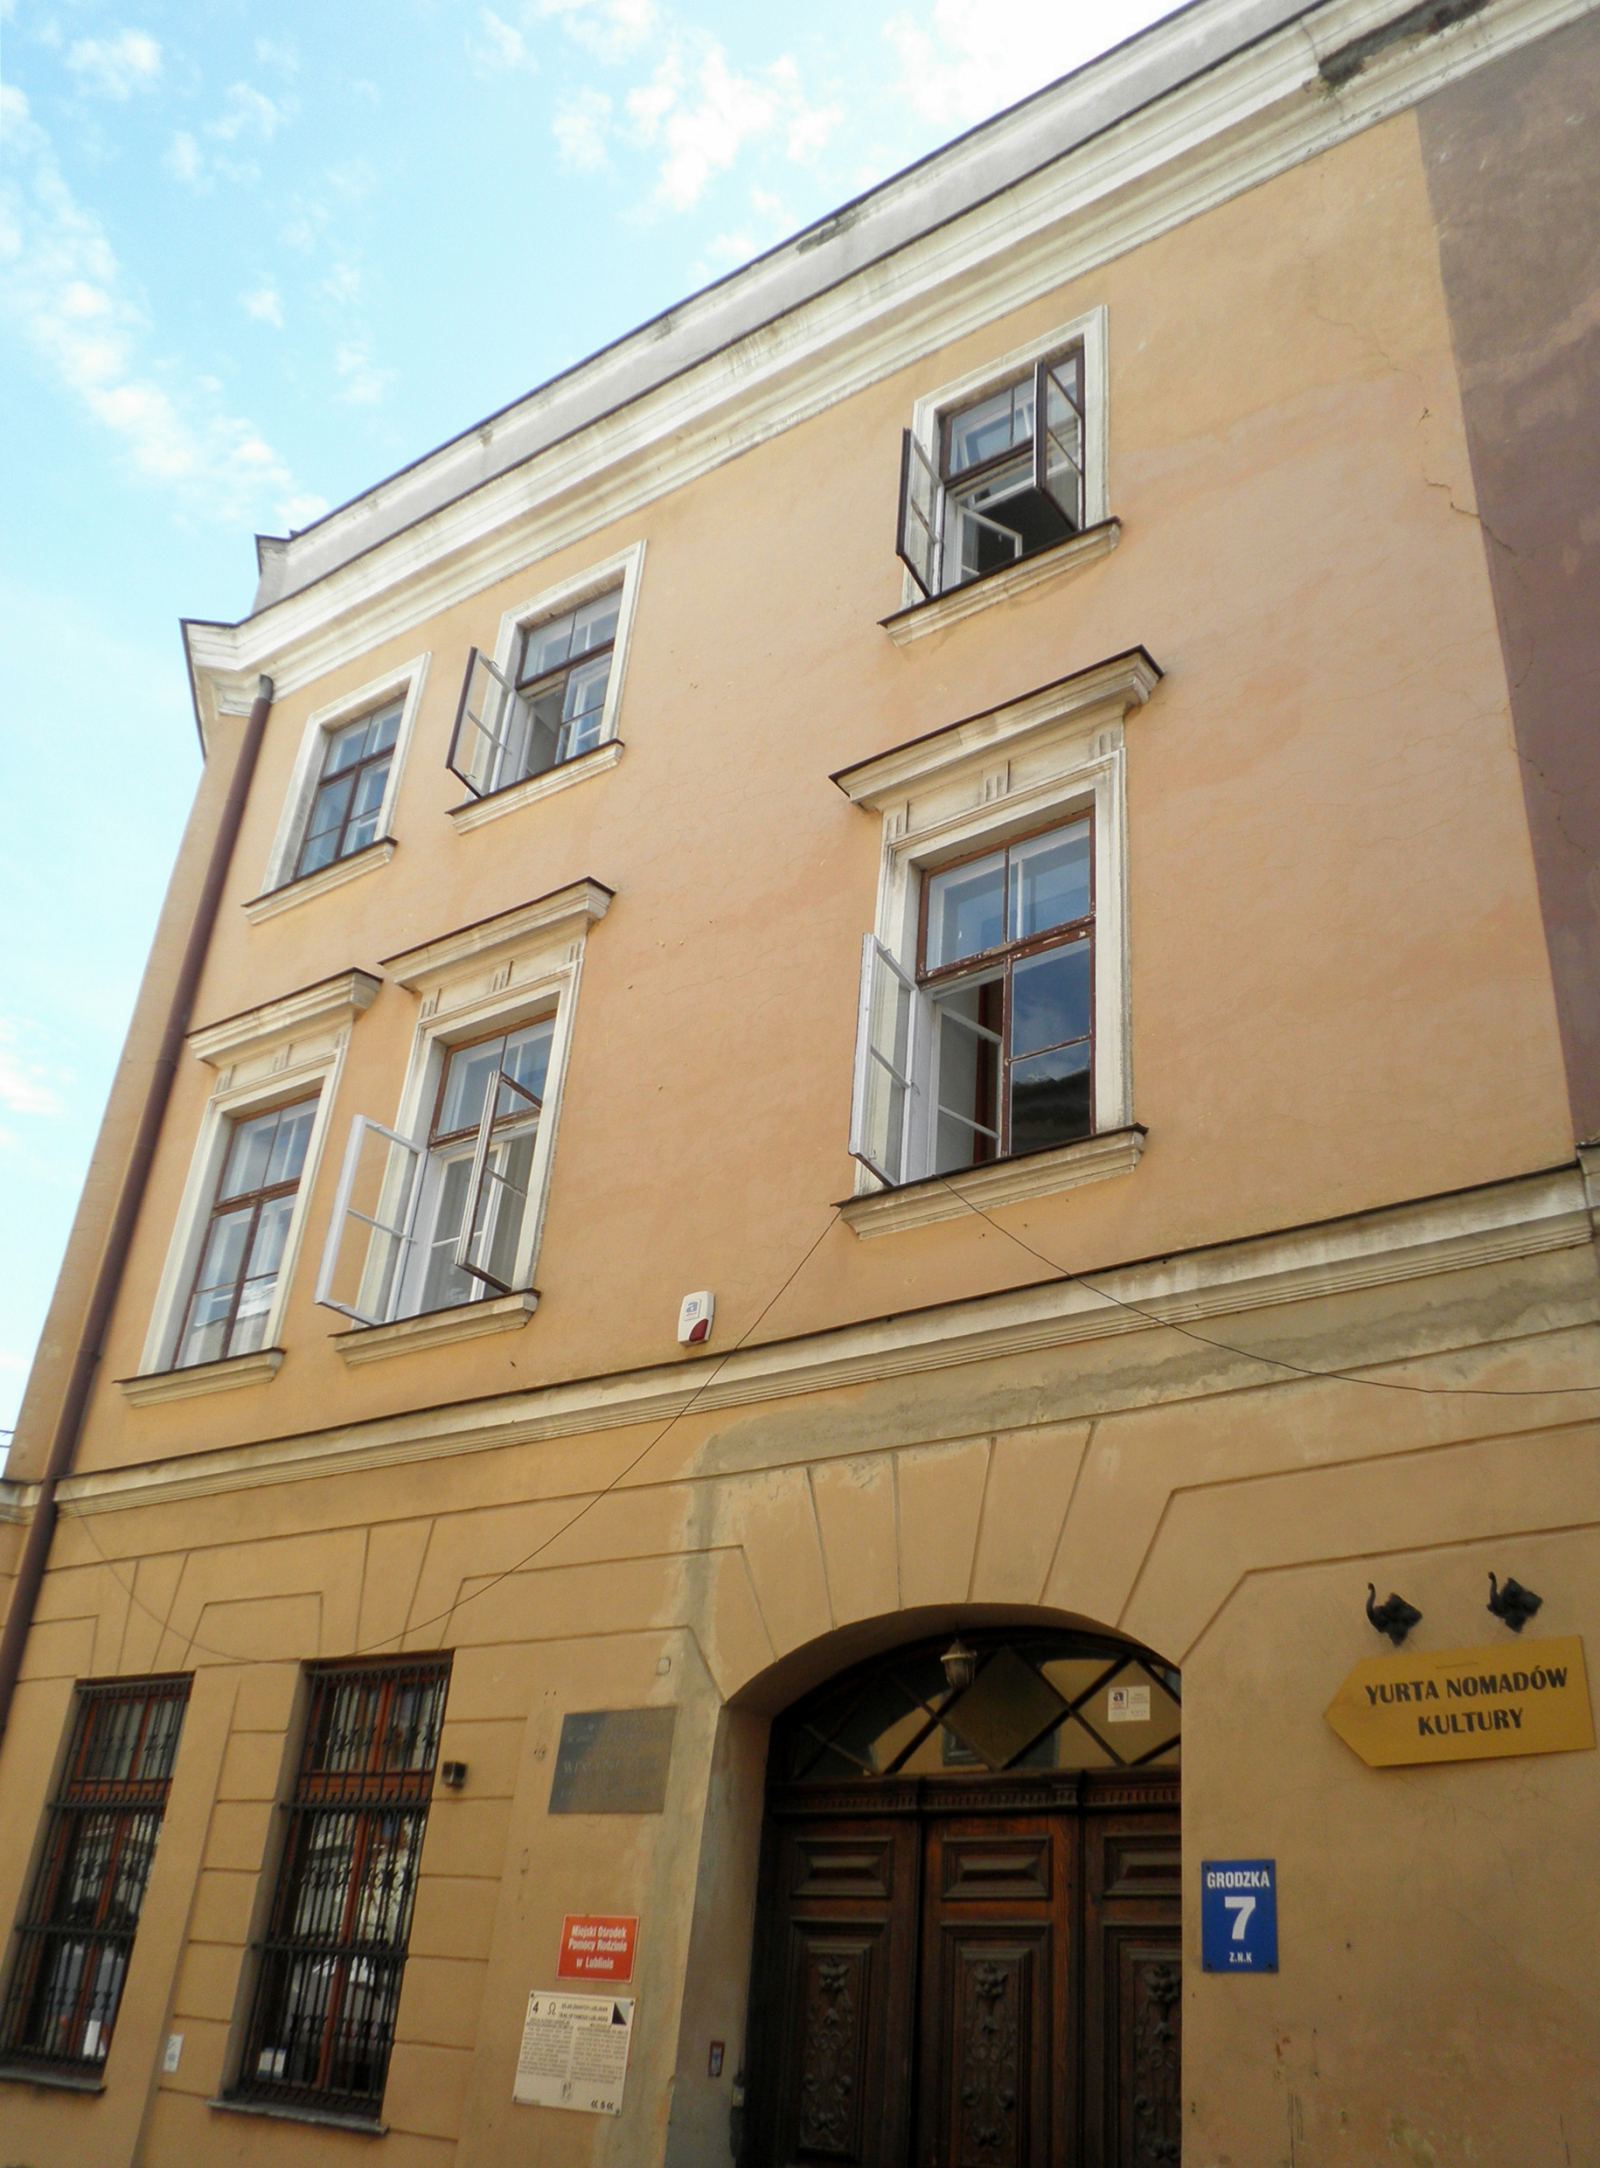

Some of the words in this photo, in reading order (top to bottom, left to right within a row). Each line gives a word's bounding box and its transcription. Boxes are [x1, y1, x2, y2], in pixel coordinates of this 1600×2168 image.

[1365, 1680, 1440, 1706] YURTA
[1446, 1665, 1568, 1699] NOMADÓW
[1418, 1707, 1524, 1736] KULTURY
[1207, 1871, 1270, 1888] GRODZKA
[1224, 1896, 1256, 1940] 7
[571, 1925, 597, 1939] Miejski
[576, 1958, 584, 1969] w
[585, 1956, 614, 1970] Lublinie
[532, 2001, 539, 2014] 4
